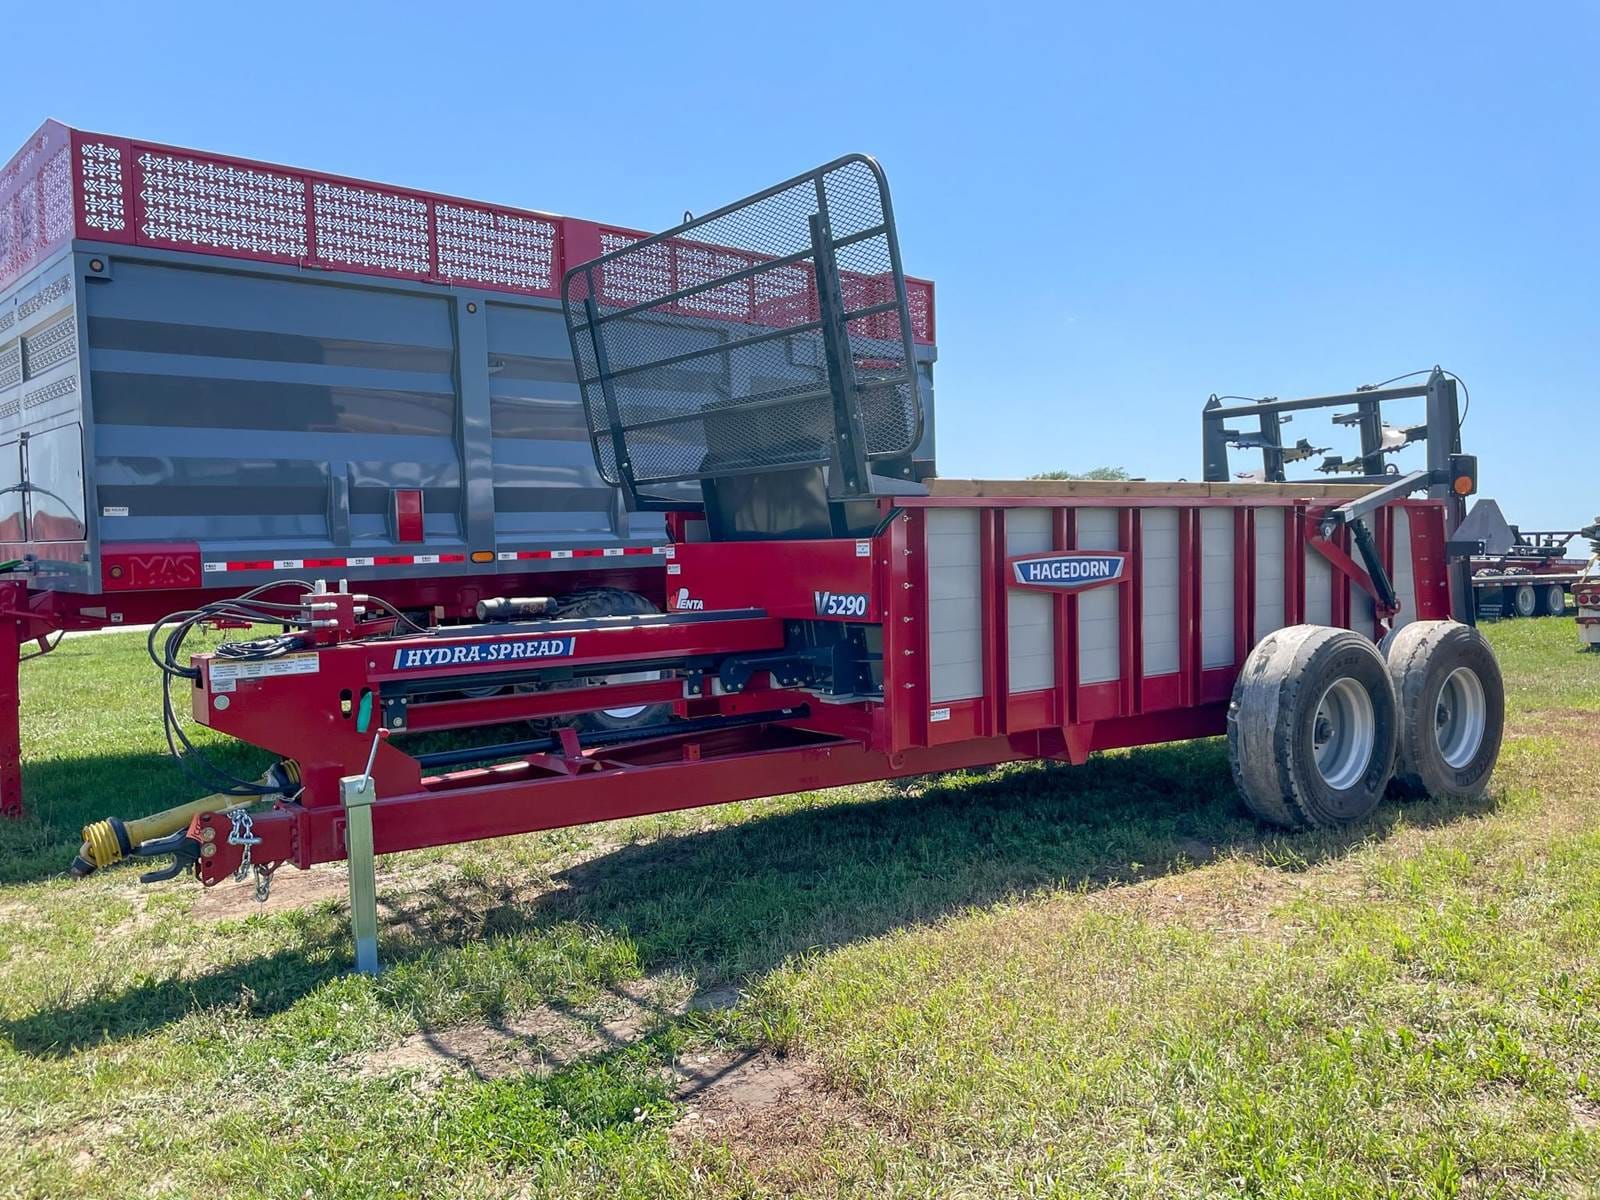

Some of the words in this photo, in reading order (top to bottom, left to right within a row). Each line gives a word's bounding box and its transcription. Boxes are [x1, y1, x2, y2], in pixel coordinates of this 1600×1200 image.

[1030, 560, 1110, 580] HAGEDORN
[676, 587, 704, 610] PENTA
[814, 591, 866, 617] V5290
[405, 639, 564, 667] HYDRA-SPREAD
